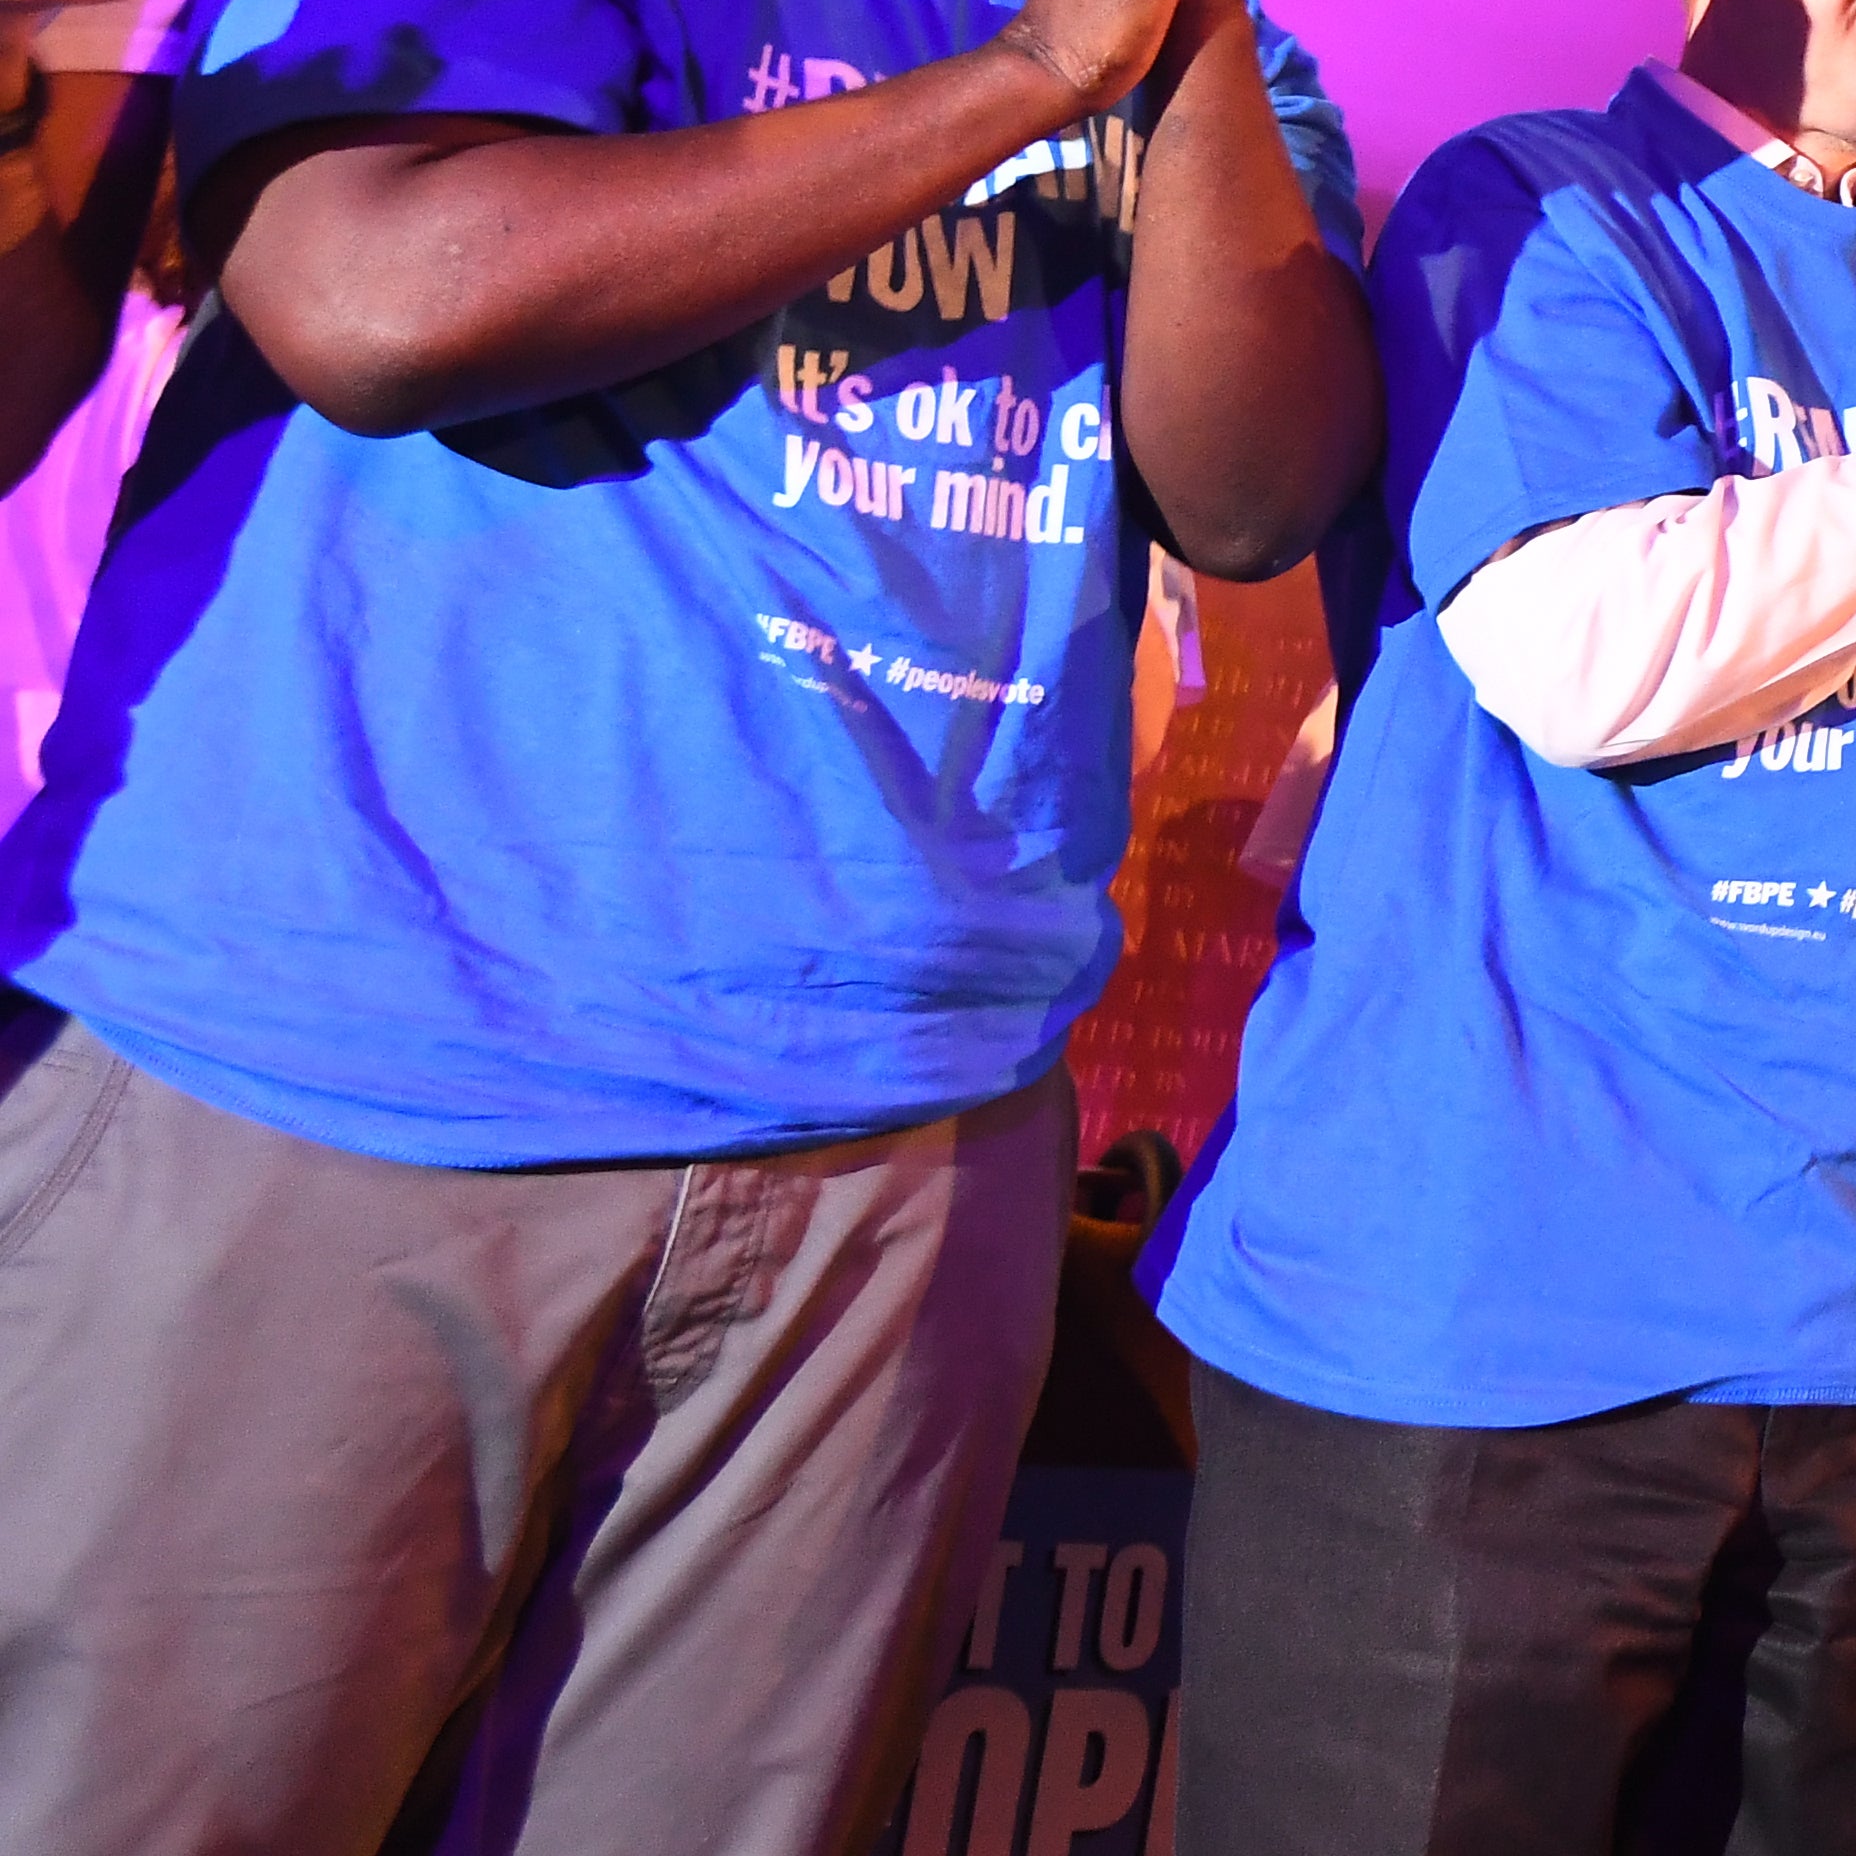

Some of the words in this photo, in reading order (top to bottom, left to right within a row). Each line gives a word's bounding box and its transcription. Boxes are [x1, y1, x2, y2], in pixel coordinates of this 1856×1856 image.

[777, 344, 875, 434] It's
[896, 365, 977, 448] ok
[993, 374, 1041, 458] to
[772, 435, 917, 522] your
[930, 457, 1085, 544] mind.
[1721, 720, 1856, 779] your
[1711, 880, 1797, 908] #FBPE
[1051, 1541, 1169, 1672] TO
